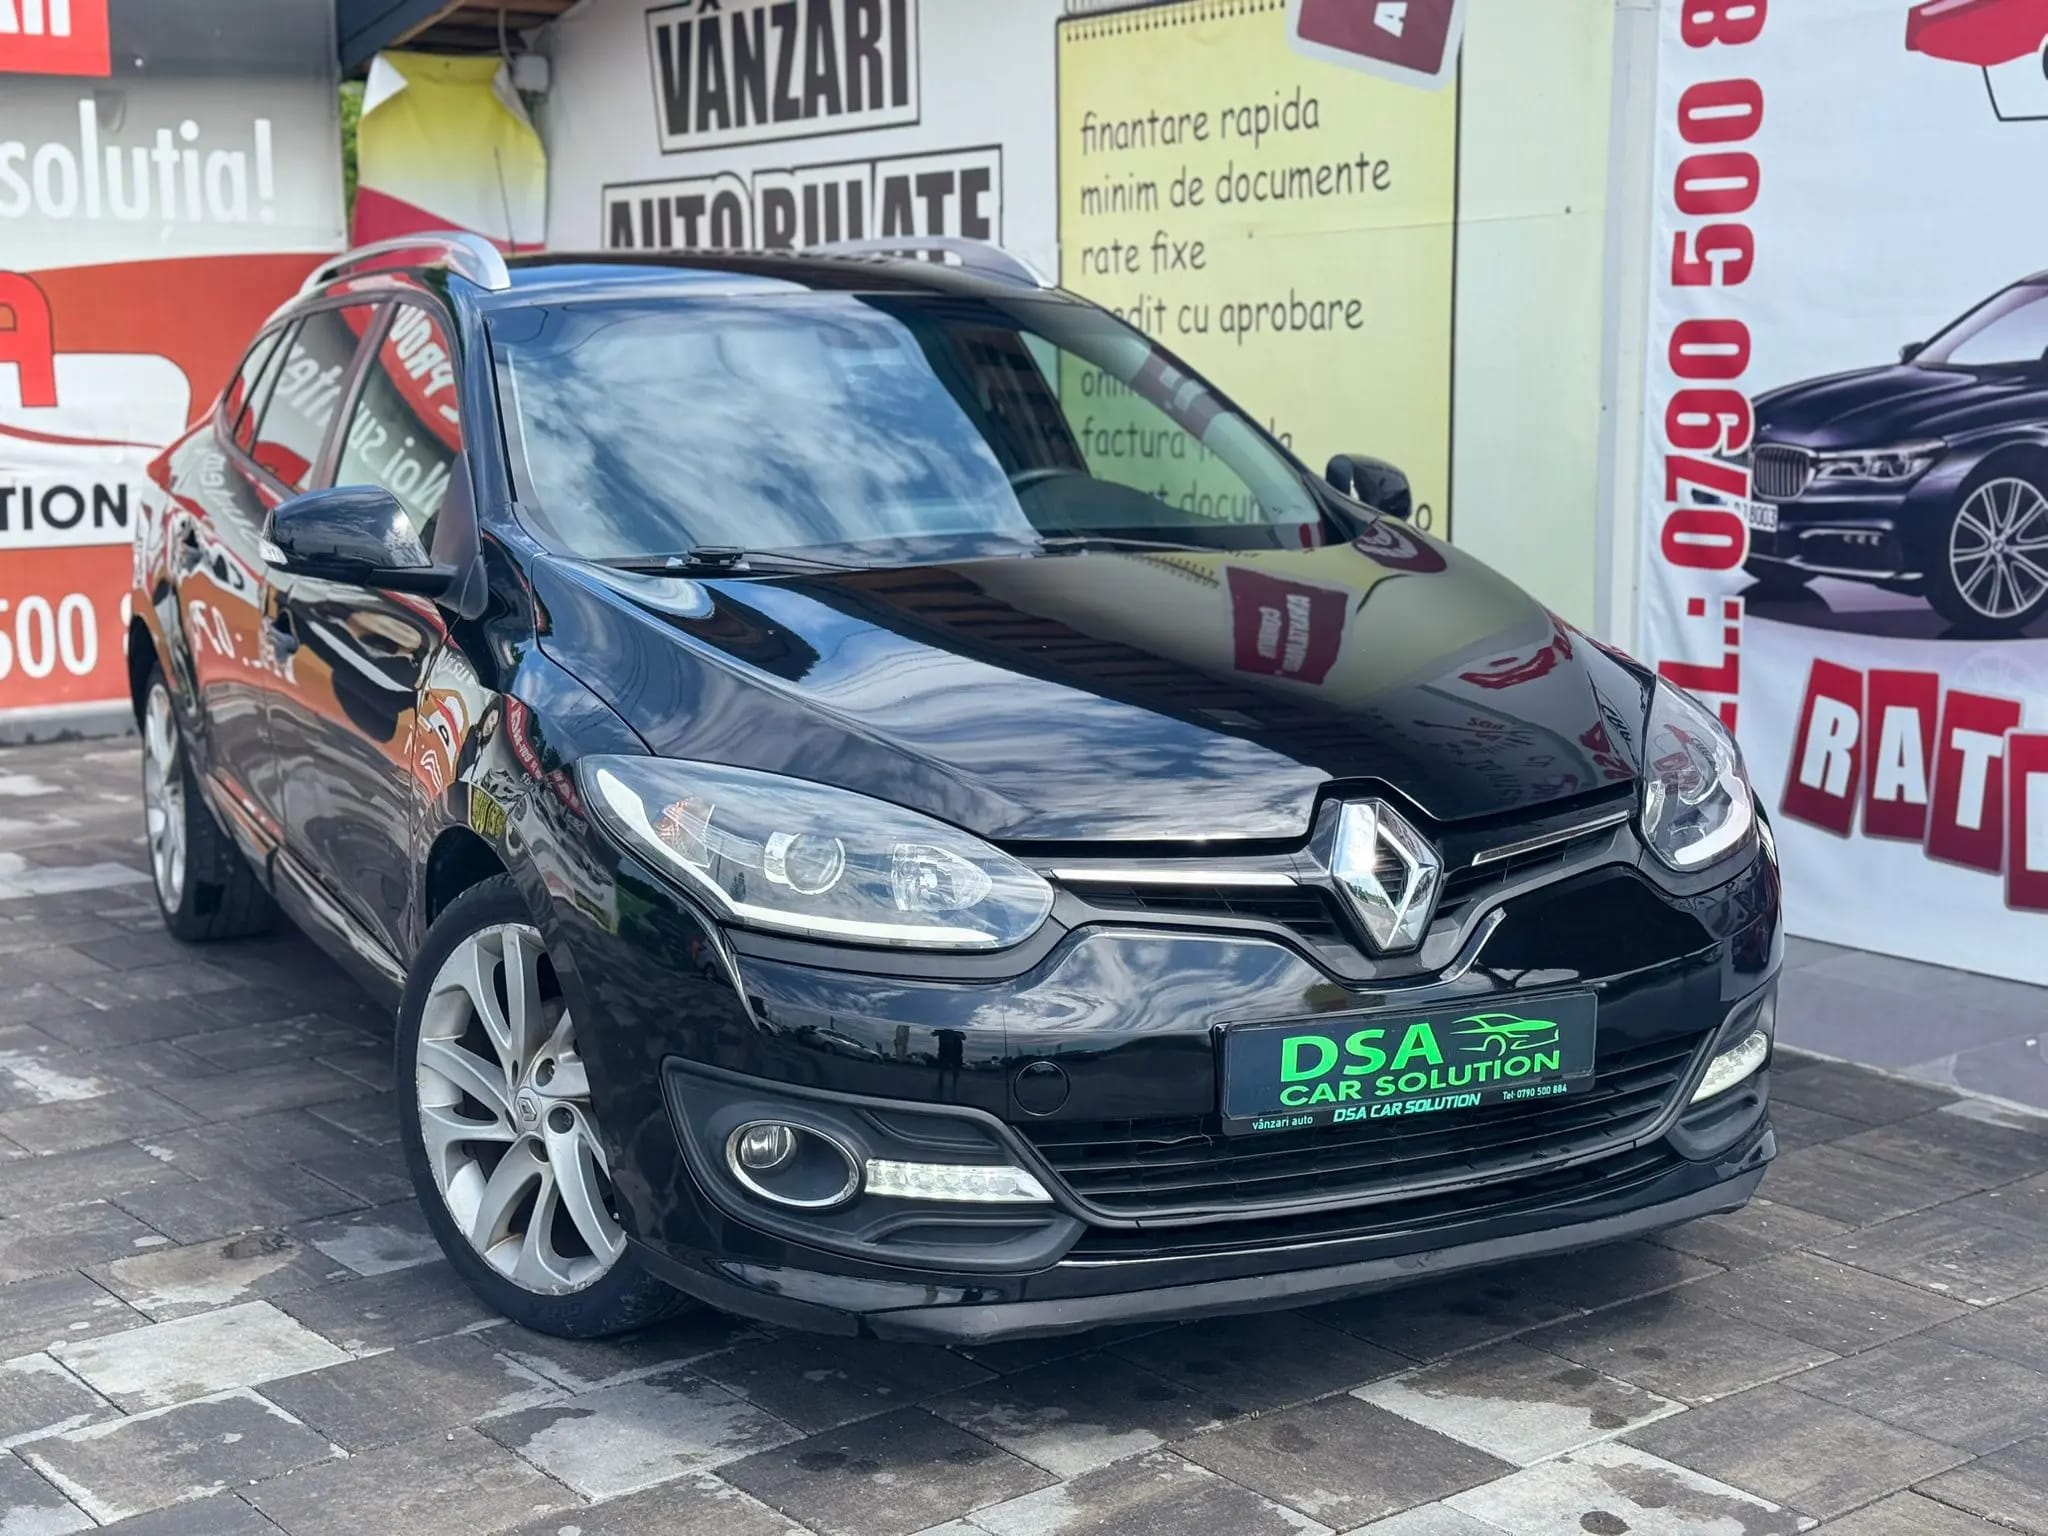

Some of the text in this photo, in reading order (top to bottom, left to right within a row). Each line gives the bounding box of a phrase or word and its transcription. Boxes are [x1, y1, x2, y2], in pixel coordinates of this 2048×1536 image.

[656, 0, 909, 136] VÂNZARI
[1080, 85, 1320, 156] finantare rapida
[1080, 151, 1392, 216] minim de documente
[1670, 78, 1764, 287] 500
[1081, 229, 1208, 276] rate fixe
[1177, 304, 1209, 334] cu
[1219, 287, 1365, 347] aprobare
[1081, 416, 1186, 459] factura
[1660, 318, 1752, 571] 0790
[1280, 1022, 1444, 1083] DSA
[1280, 1050, 1561, 1107] CAR SOLUTION
[1291, 1115, 1313, 1127] auto
[1333, 1105, 1367, 1123] DSA
[1370, 1103, 1403, 1119] CAR
[1403, 1093, 1482, 1115] SOLUTION
[1537, 1086, 1552, 1096] 500
